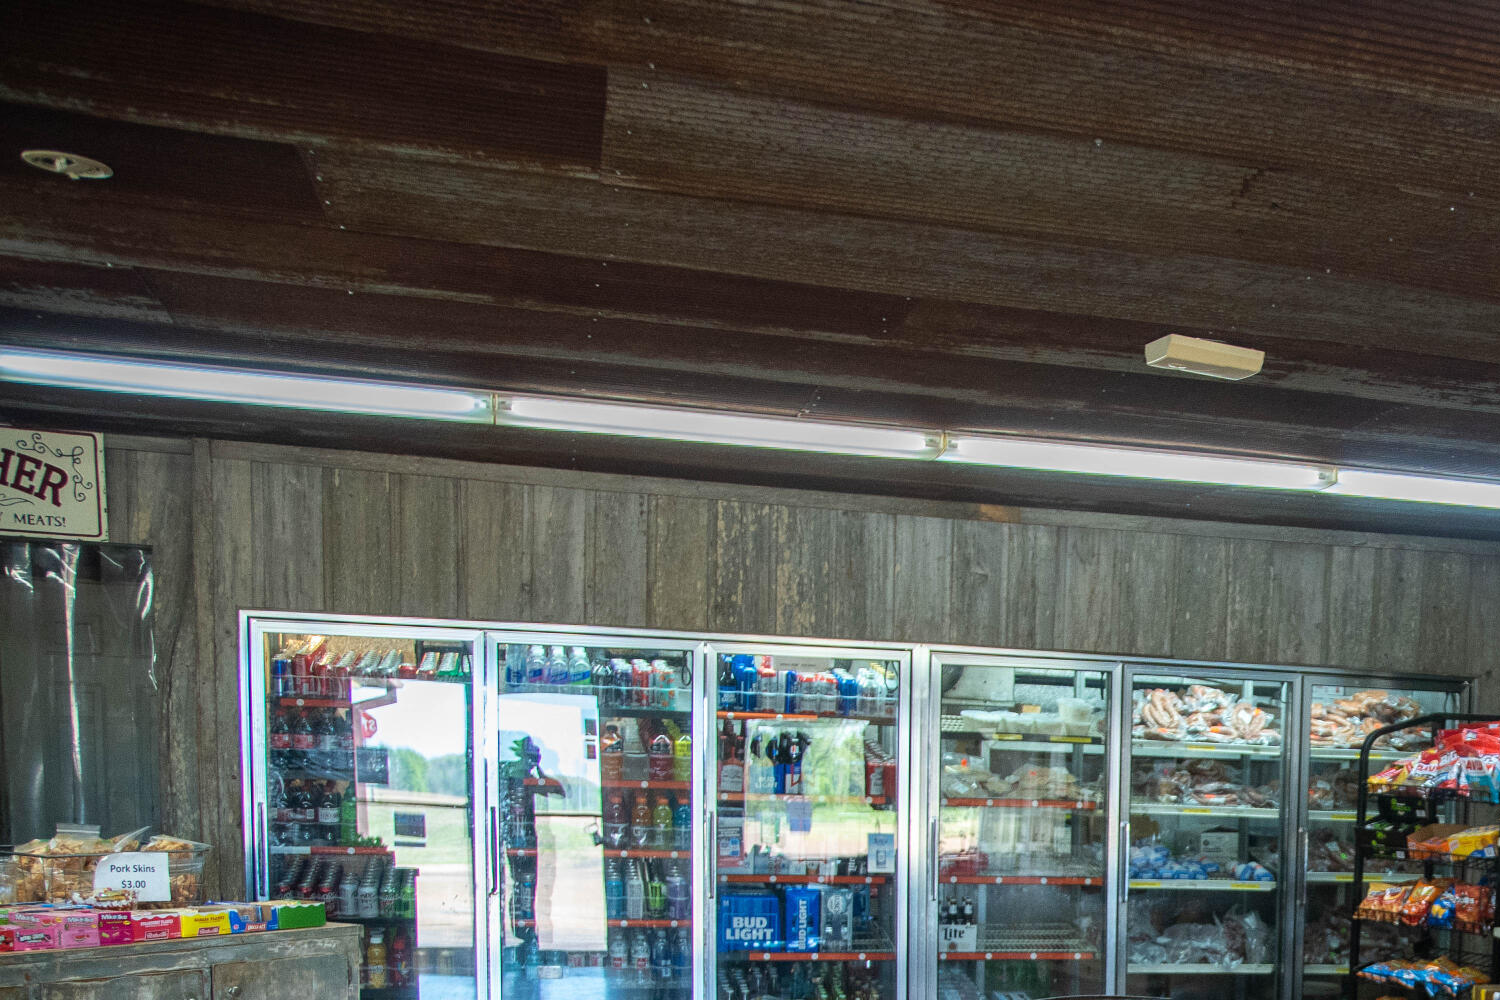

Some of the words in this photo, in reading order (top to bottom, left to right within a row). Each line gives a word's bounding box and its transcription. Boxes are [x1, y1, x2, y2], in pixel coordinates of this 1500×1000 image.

[14, 513, 67, 528] MEATS!
[110, 864, 131, 873] Pork
[133, 864, 156, 873] Skins
[121, 879, 147, 889] $3.00
[799, 899, 808, 929] LIGHT
[732, 916, 768, 929] BUD
[725, 929, 774, 941] LIGHT
[943, 927, 966, 941] Lite
